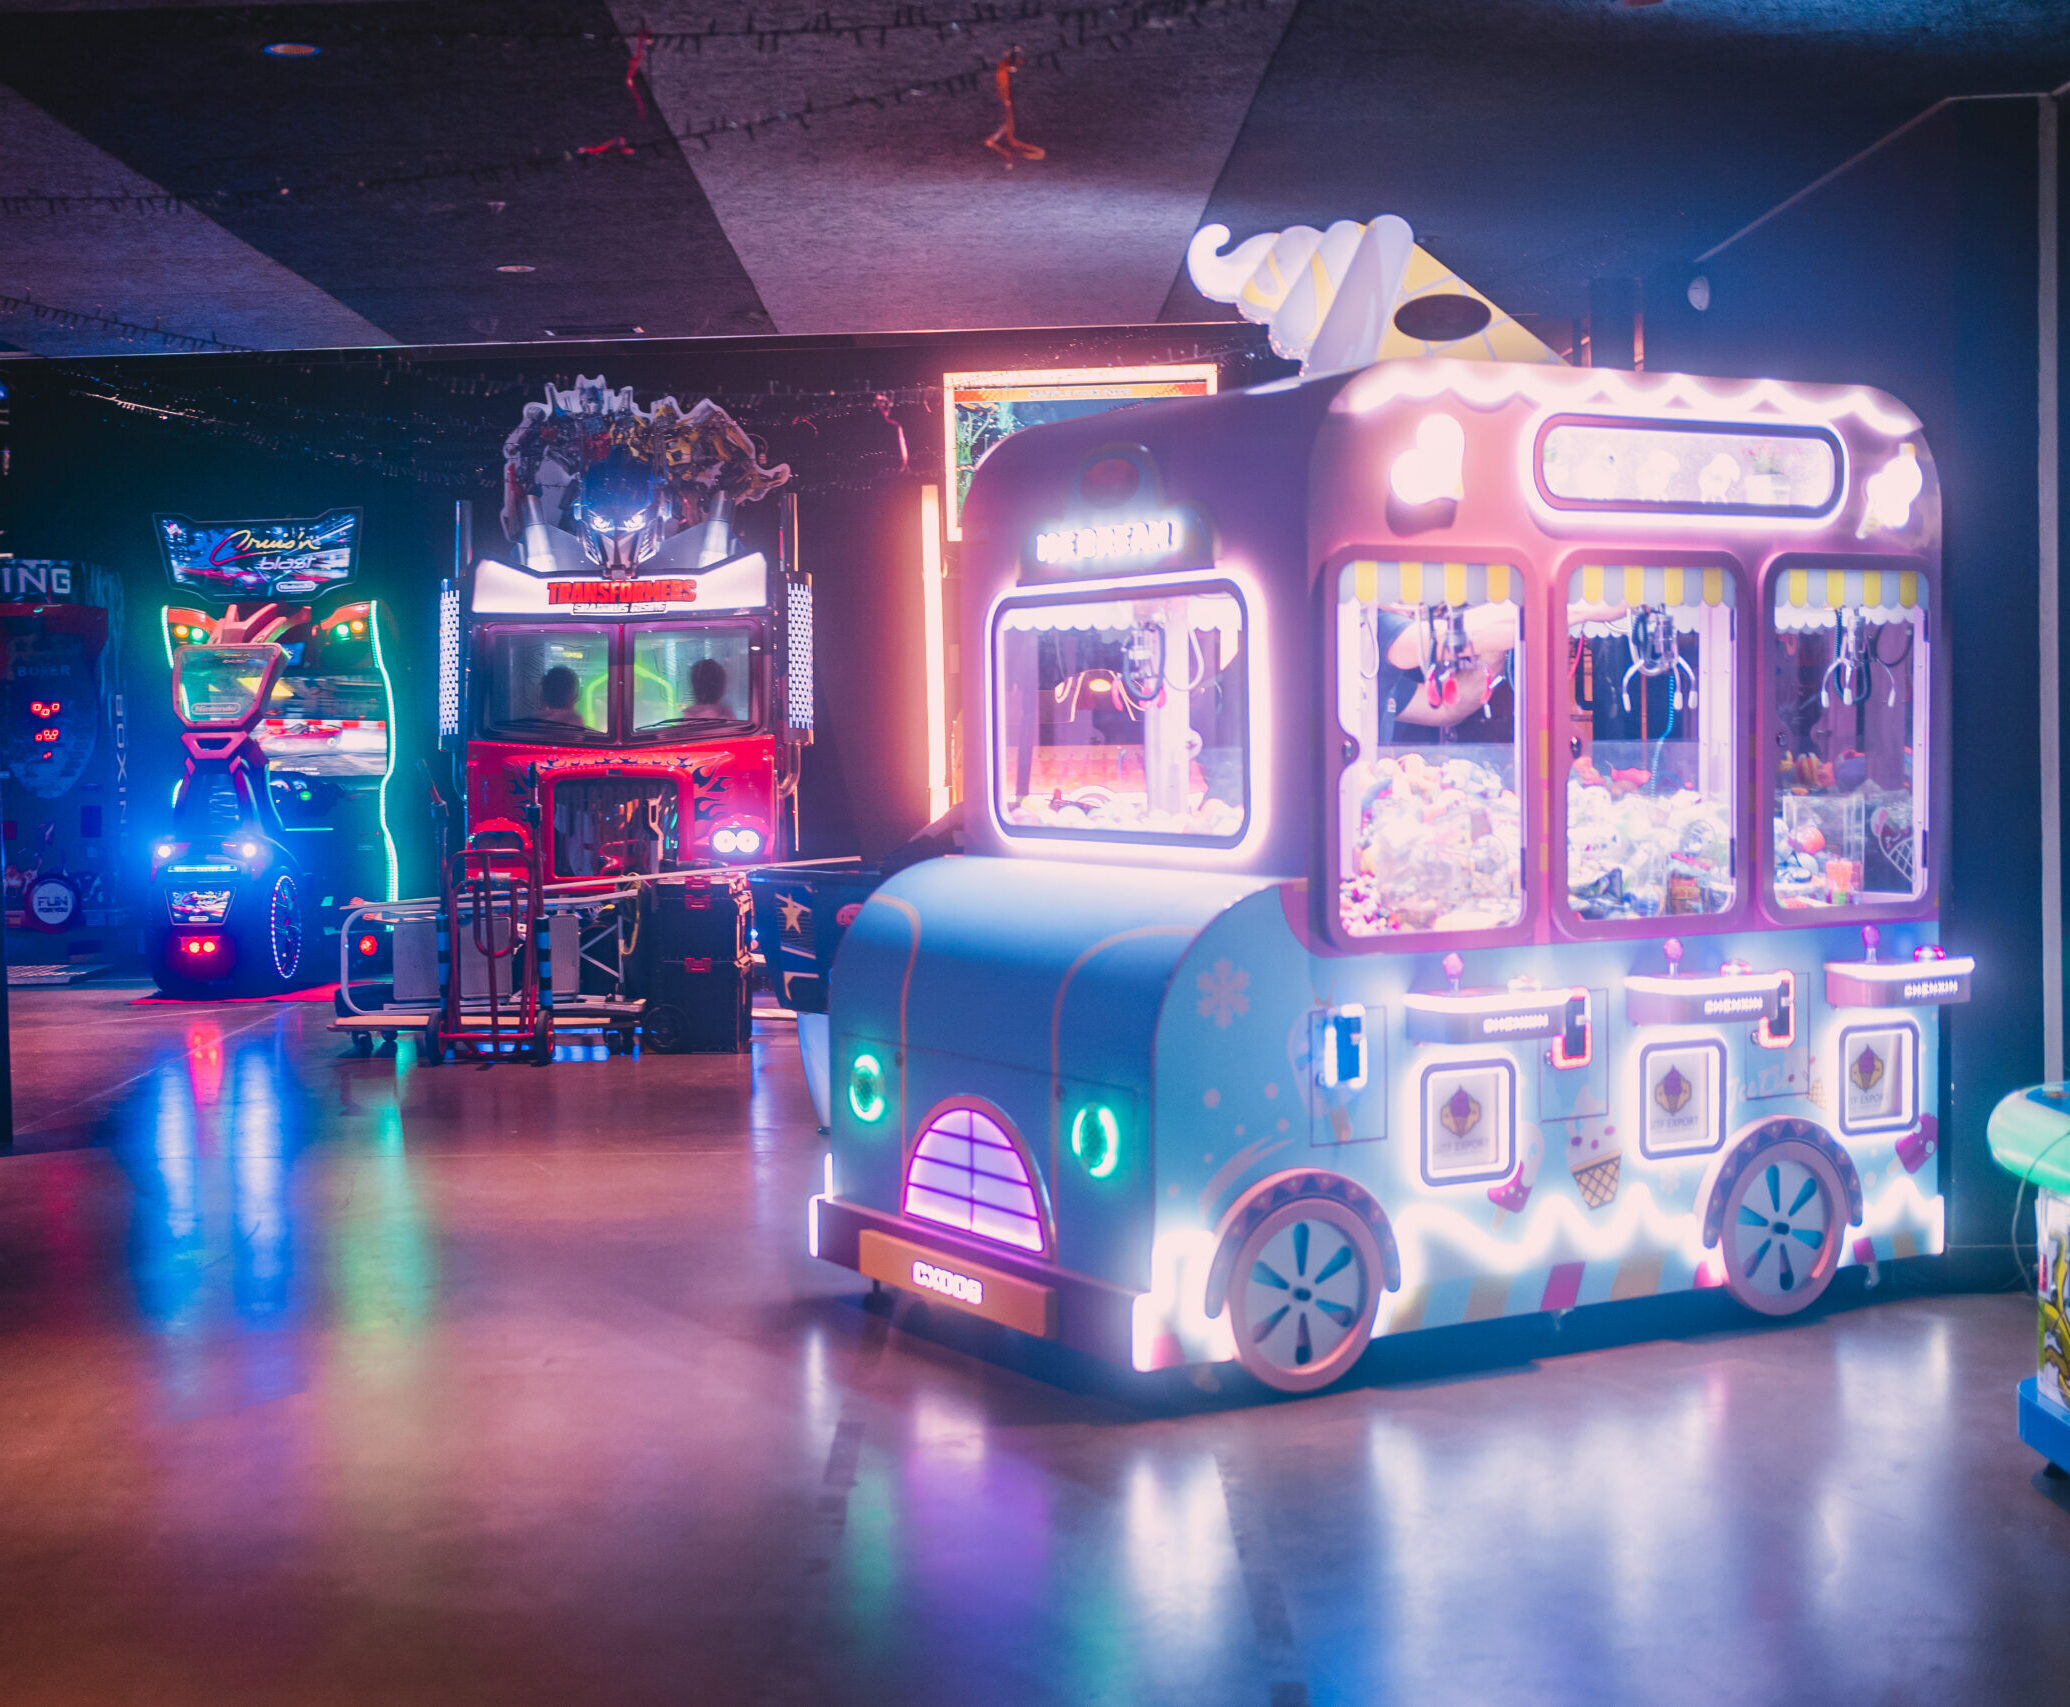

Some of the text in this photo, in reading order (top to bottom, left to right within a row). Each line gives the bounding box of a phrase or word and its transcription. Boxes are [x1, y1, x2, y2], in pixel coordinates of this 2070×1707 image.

[256, 556, 317, 571] blast
[547, 579, 698, 605] TRANSFORMERS
[37, 896, 68, 906] FUN
